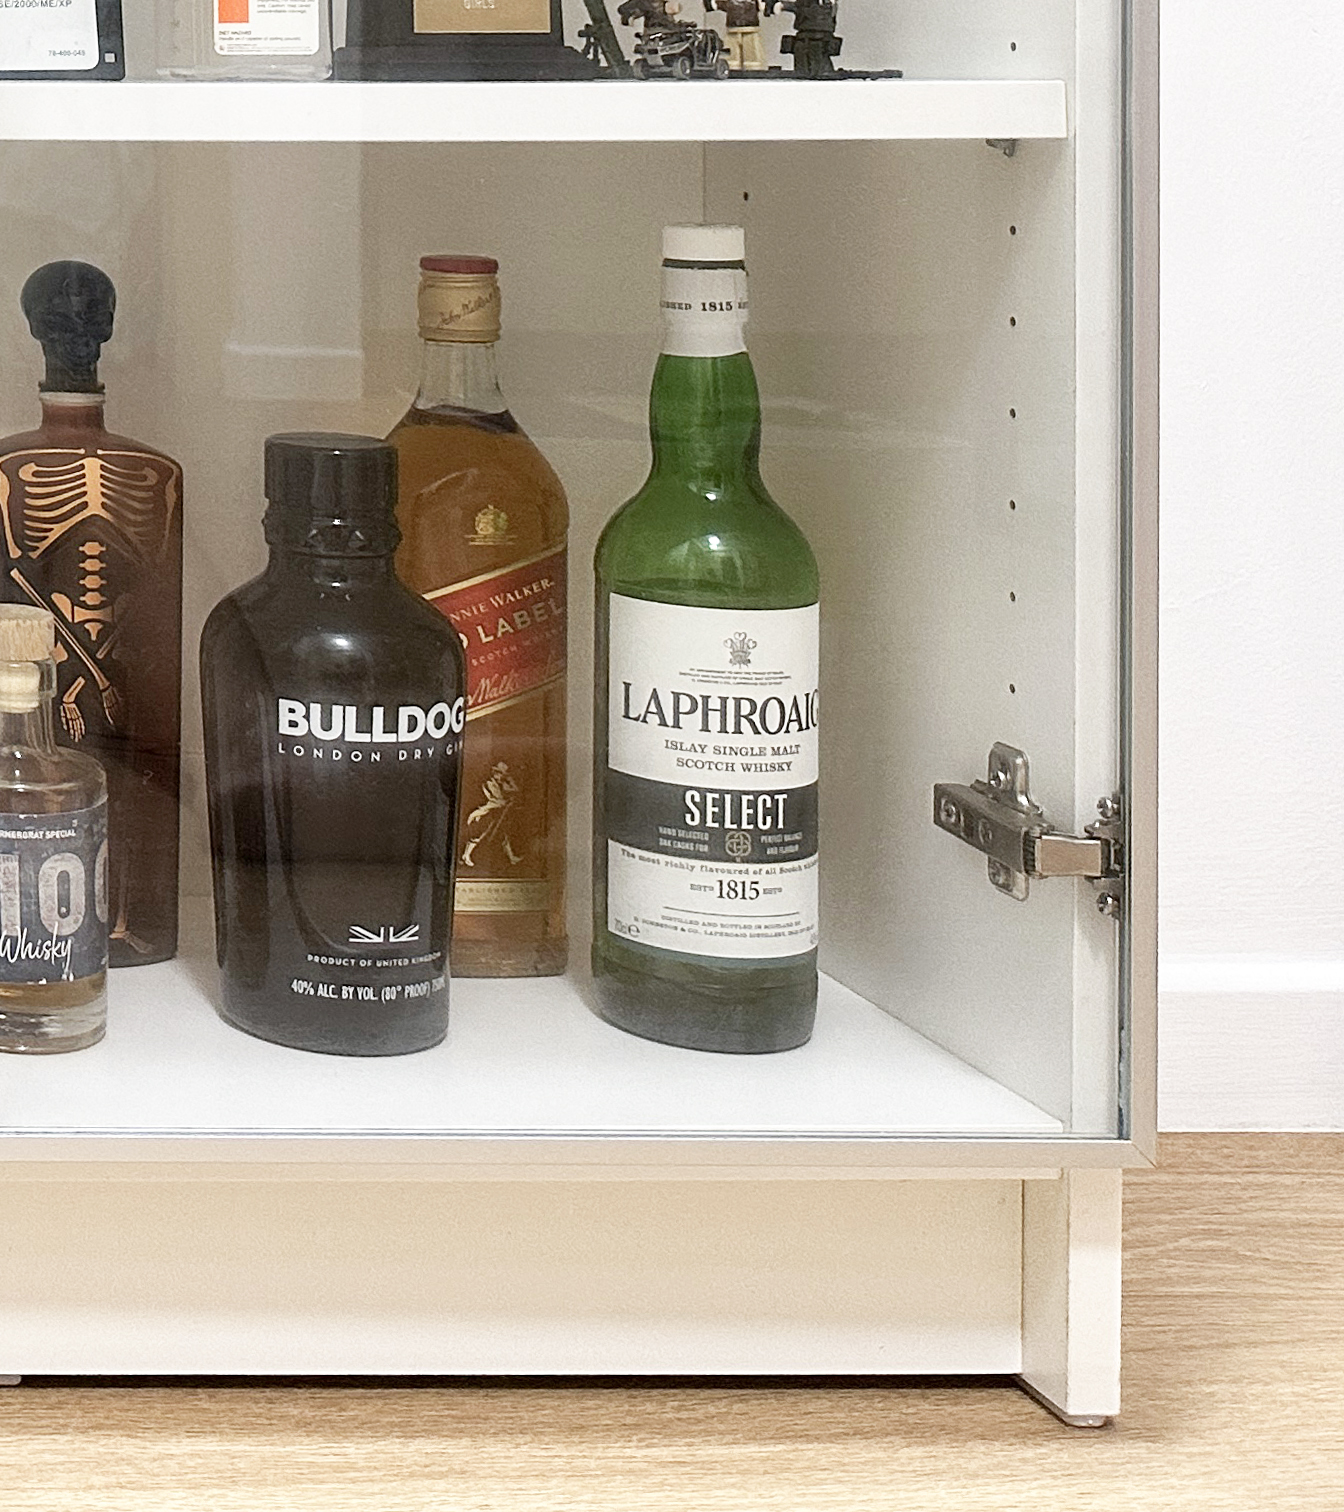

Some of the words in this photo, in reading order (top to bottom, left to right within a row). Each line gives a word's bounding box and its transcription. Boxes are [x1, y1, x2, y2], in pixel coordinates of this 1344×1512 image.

[701, 301, 734, 312] 1815
[449, 602, 489, 624] NNIE
[476, 597, 563, 645] LABEL
[278, 696, 464, 743] BULLDOG
[278, 742, 381, 763] LONDON
[398, 746, 435, 762] DRY
[664, 739, 708, 754] ISLAY
[712, 743, 767, 757] SINGLE
[771, 744, 801, 756] MALT
[676, 757, 736, 773] SCOTCH
[741, 760, 793, 773] WHISKY
[684, 789, 788, 830] SELECT
[44, 828, 77, 838] SPECIAL
[620, 848, 637, 859] The
[638, 853, 661, 865] most
[664, 858, 696, 873] richly
[700, 863, 750, 876] flavoured
[753, 867, 763, 876] of
[765, 866, 777, 875] all
[716, 879, 761, 901] 1815
[0, 921, 72, 973] Whisky
[307, 953, 356, 967] PRODUCT
[359, 959, 372, 967] OF
[376, 958, 410, 967] UNITED
[291, 978, 315, 996] 40%
[317, 983, 339, 999] ALC.
[341, 985, 355, 1000] BY
[356, 987, 379, 1001] VOL.
